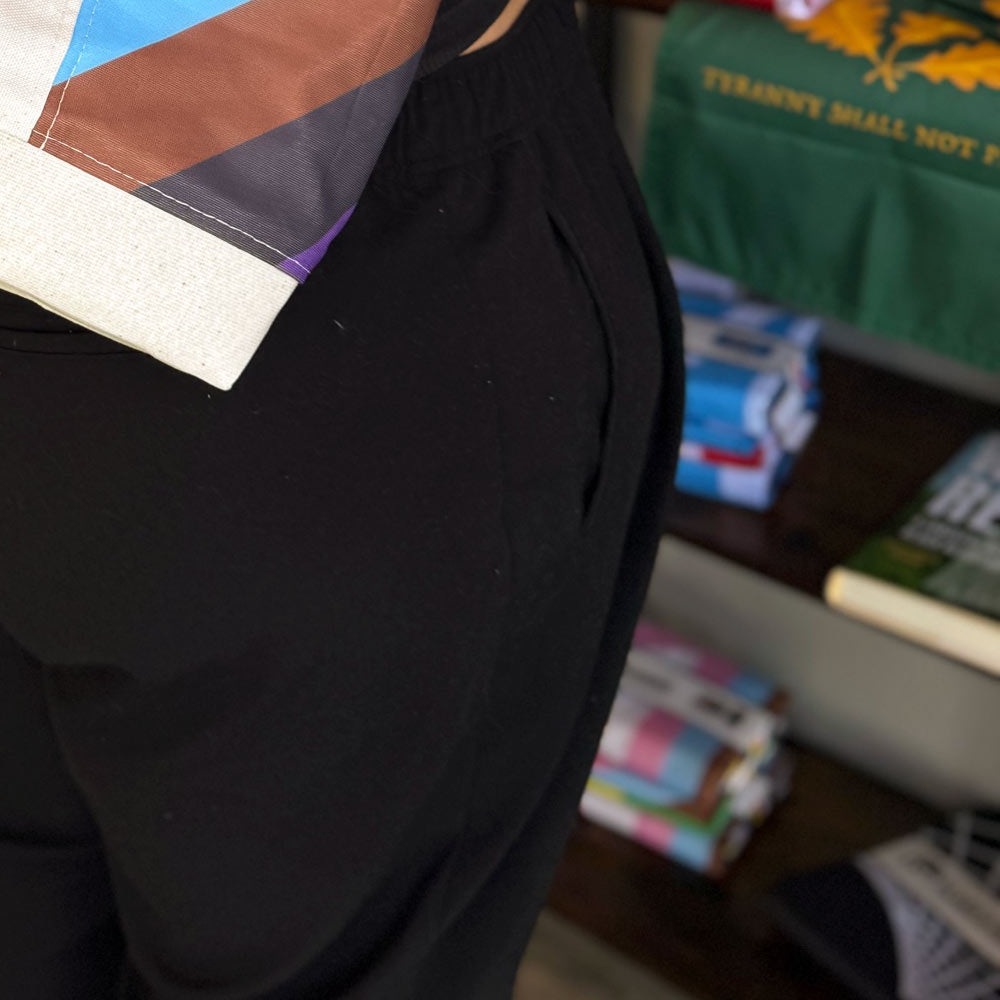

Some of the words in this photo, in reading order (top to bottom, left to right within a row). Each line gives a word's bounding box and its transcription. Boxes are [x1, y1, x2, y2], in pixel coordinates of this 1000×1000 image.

[702, 65, 824, 120] TYRANNY
[827, 101, 908, 142] SHALL
[914, 125, 979, 160] NOT
